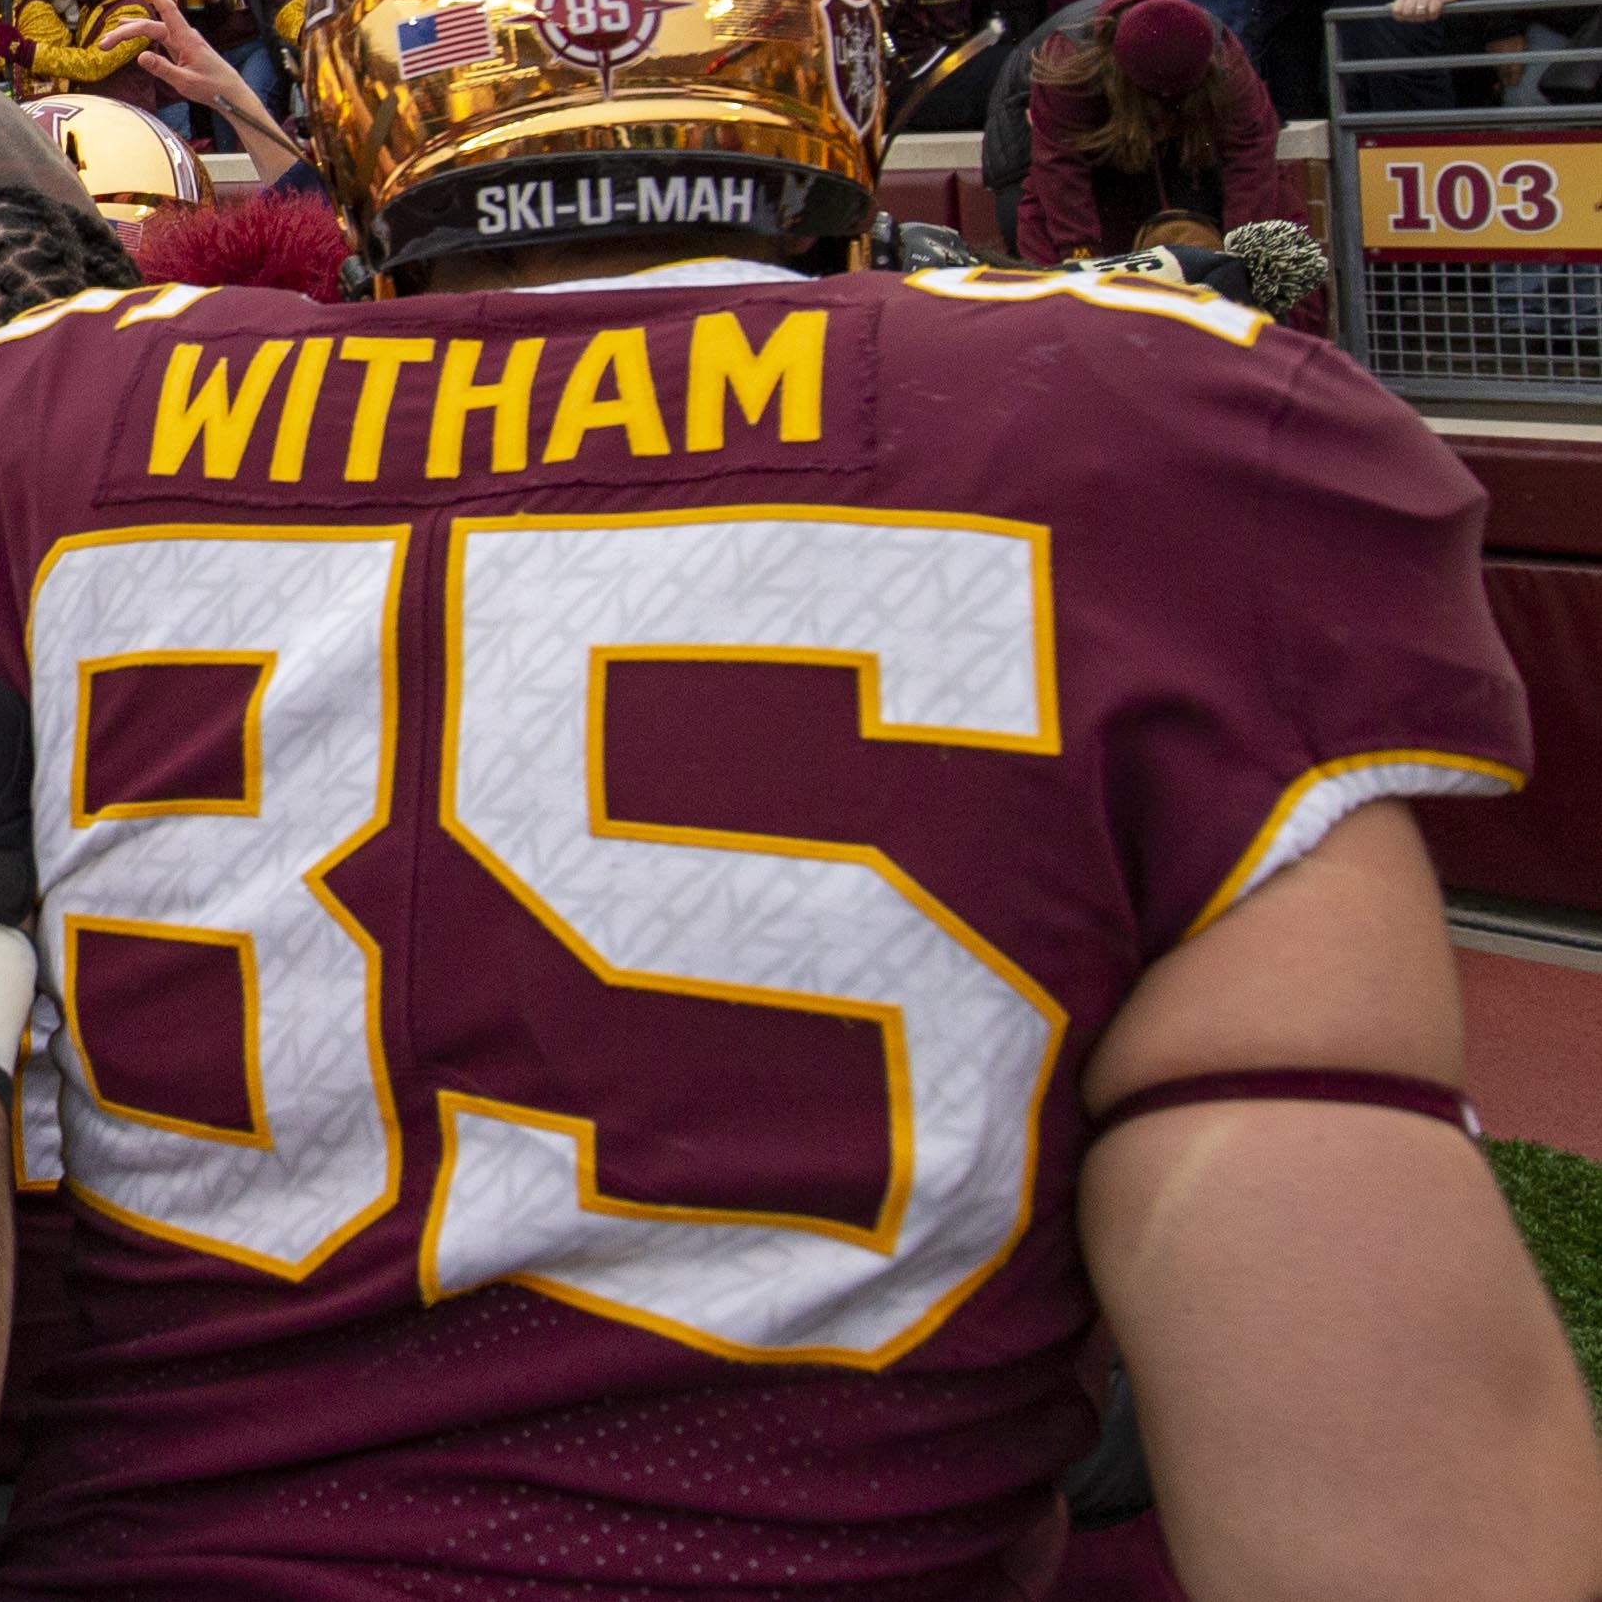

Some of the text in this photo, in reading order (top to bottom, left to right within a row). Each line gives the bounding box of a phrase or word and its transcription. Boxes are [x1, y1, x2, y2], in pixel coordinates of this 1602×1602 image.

[475, 177, 755, 236] SKI-U-MAH
[1386, 159, 1565, 234] 103
[146, 309, 830, 484] WITHAM
[21, 502, 1072, 1374] 85
